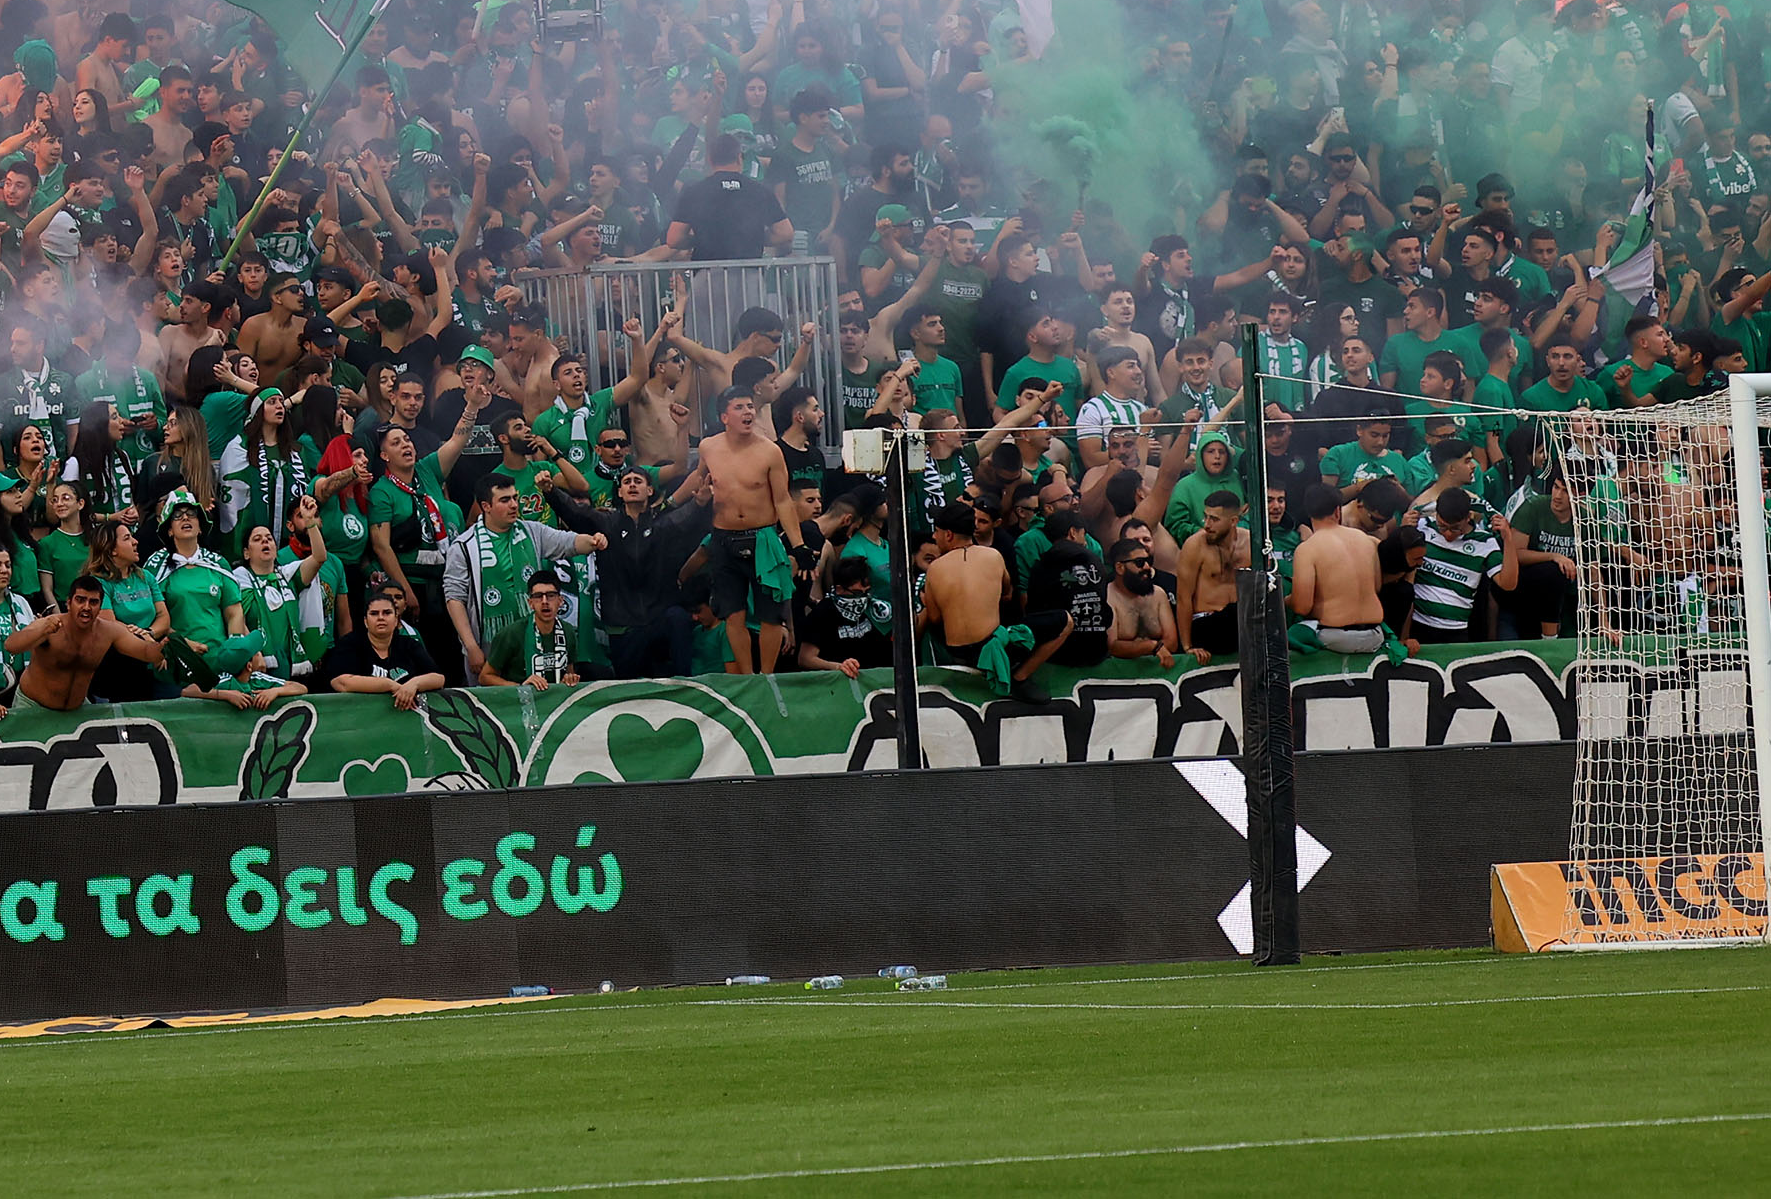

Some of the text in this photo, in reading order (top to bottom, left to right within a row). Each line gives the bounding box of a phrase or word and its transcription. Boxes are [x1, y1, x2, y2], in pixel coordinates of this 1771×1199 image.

[520, 493, 545, 515] 22
[85, 873, 200, 938] τα
[226, 846, 418, 945] δεις
[441, 826, 623, 920] εδώ
